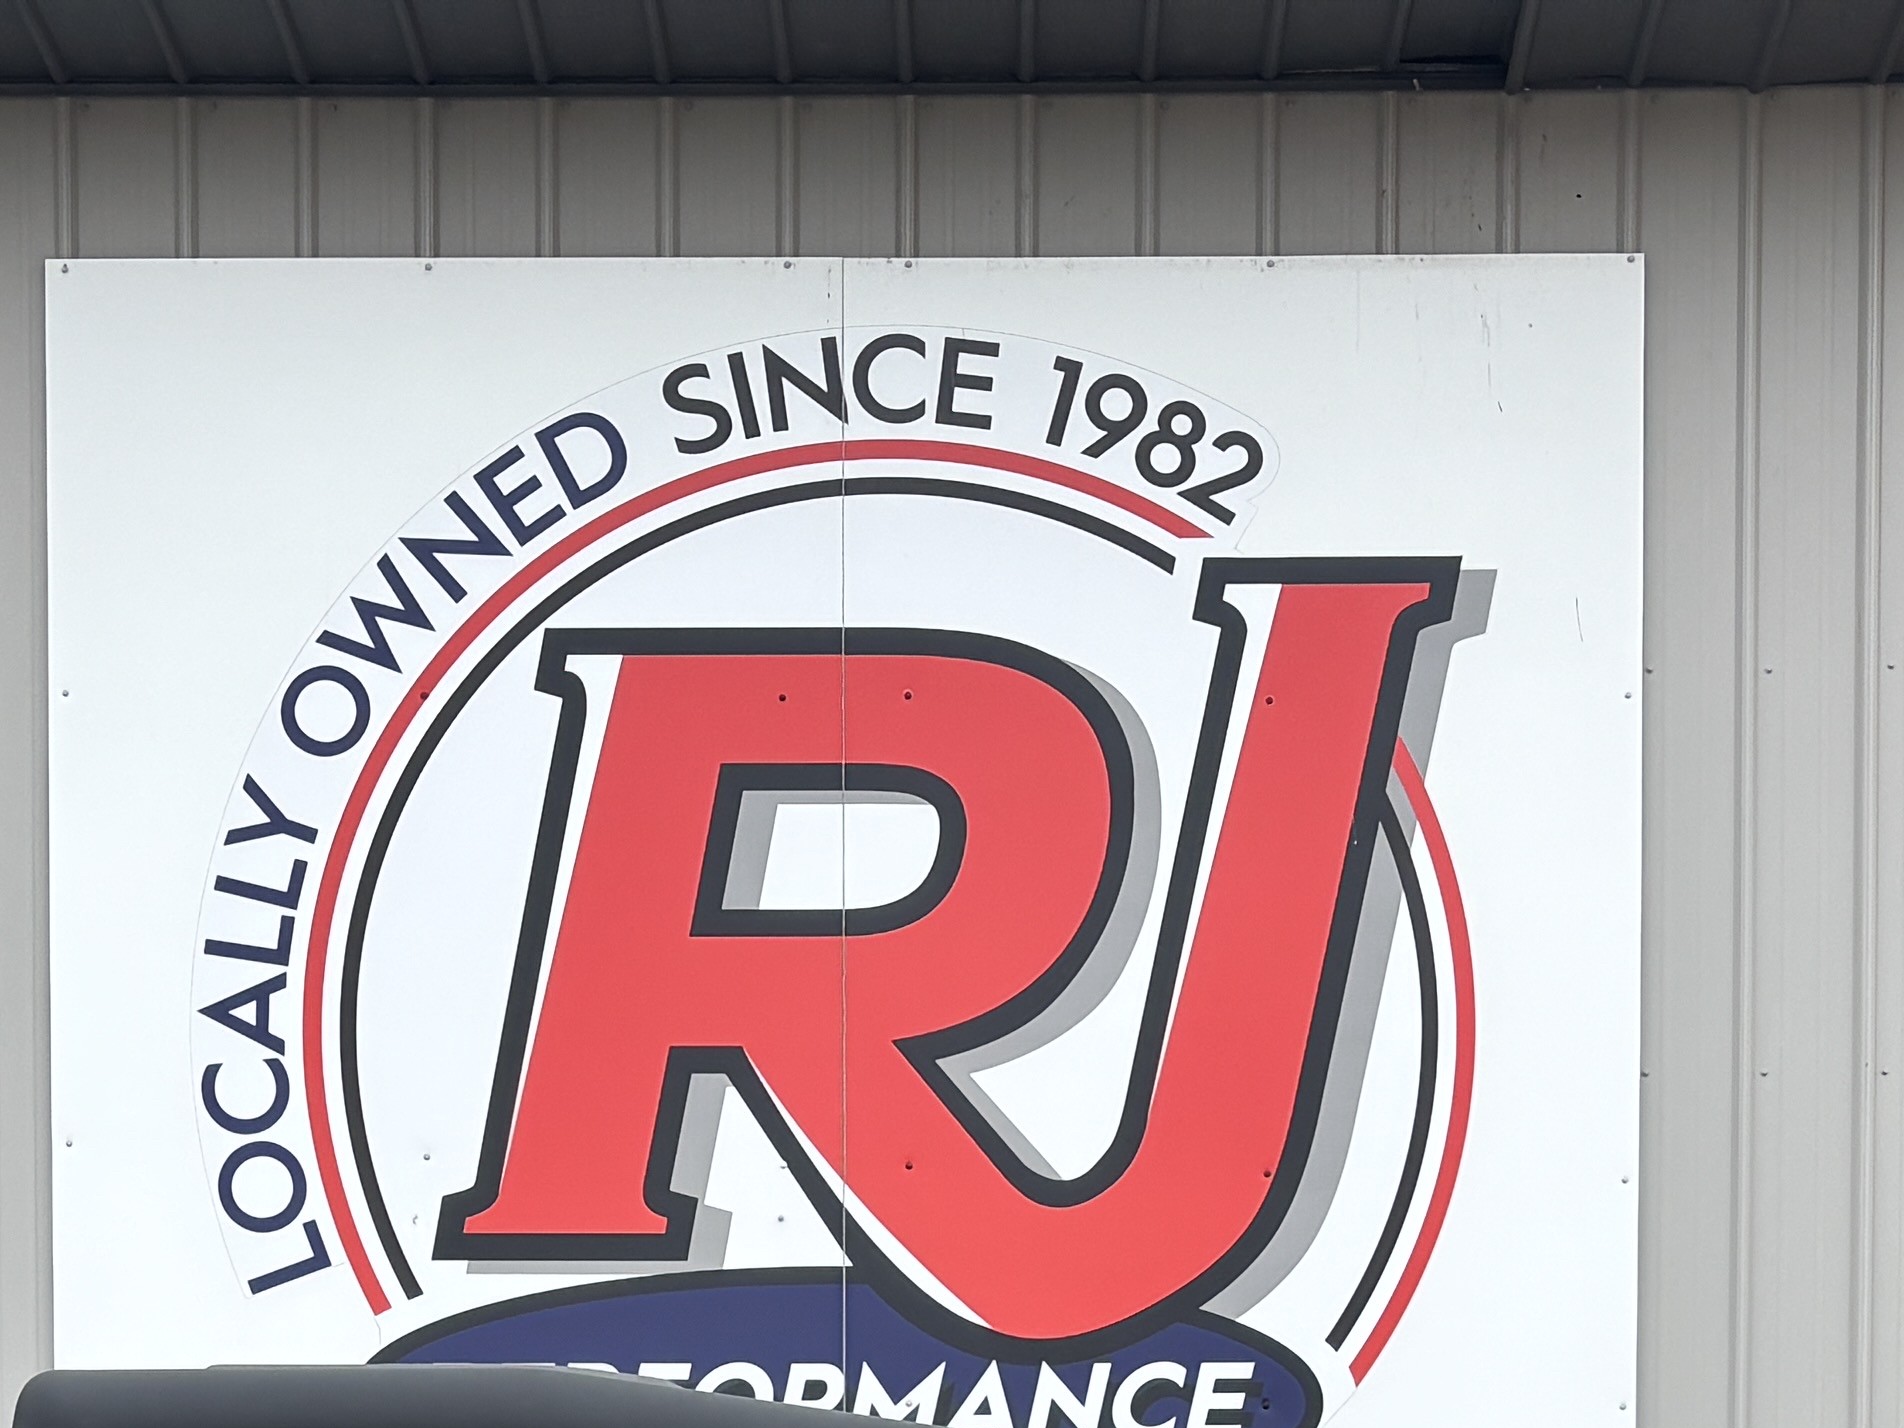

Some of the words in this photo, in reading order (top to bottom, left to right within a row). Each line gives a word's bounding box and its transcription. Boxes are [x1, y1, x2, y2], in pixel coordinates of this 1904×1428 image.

[197, 773, 332, 1295] LOCALLY
[281, 412, 627, 757] OWNED
[661, 333, 1000, 455] SINCE
[1045, 355, 1264, 526] 1982
[432, 556, 1463, 1362] RJ
